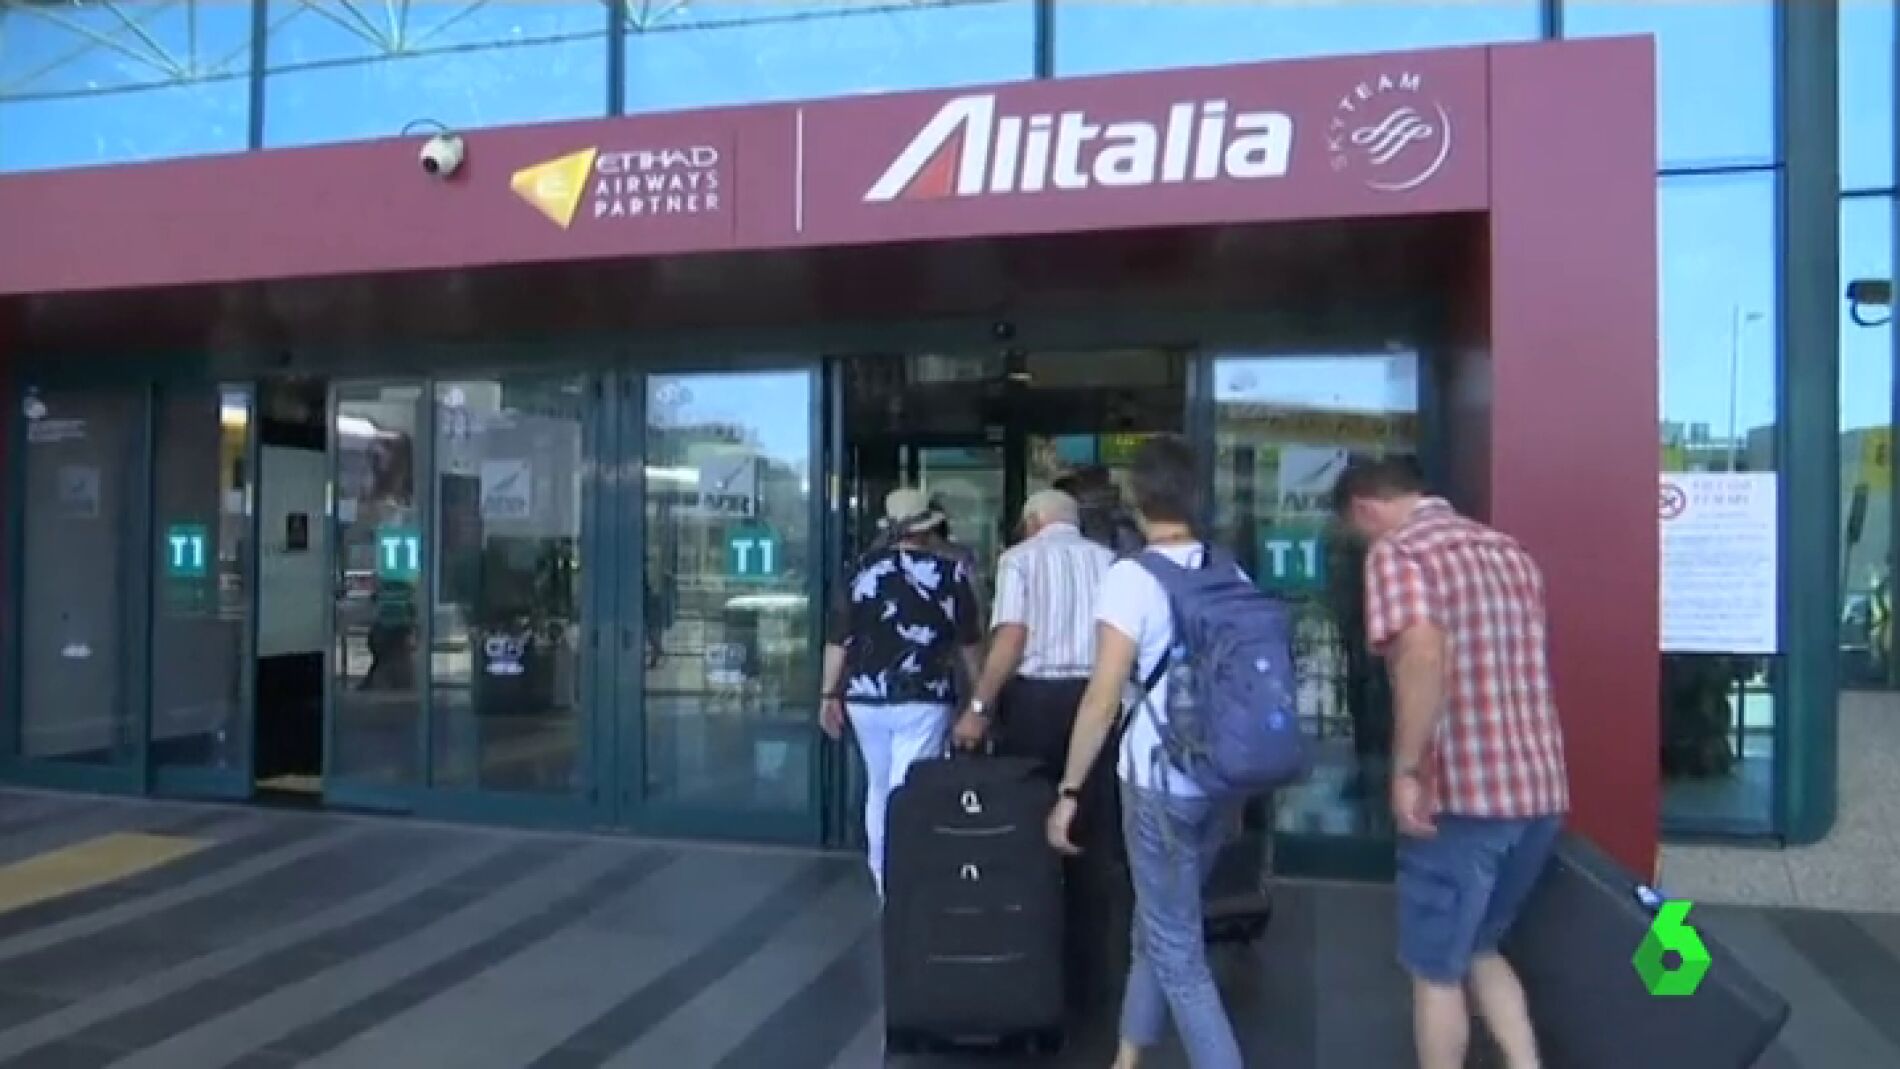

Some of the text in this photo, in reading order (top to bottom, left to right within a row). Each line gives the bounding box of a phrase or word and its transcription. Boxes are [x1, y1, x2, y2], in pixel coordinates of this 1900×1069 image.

[596, 146, 719, 174] ETIHAD
[863, 94, 1291, 201] Alitalia
[596, 170, 719, 194] AIRWAYS
[595, 193, 719, 218] PARTNER
[169, 536, 202, 567] T1
[380, 536, 418, 569] T1
[731, 539, 774, 573] T1
[1265, 539, 1316, 577] T1
